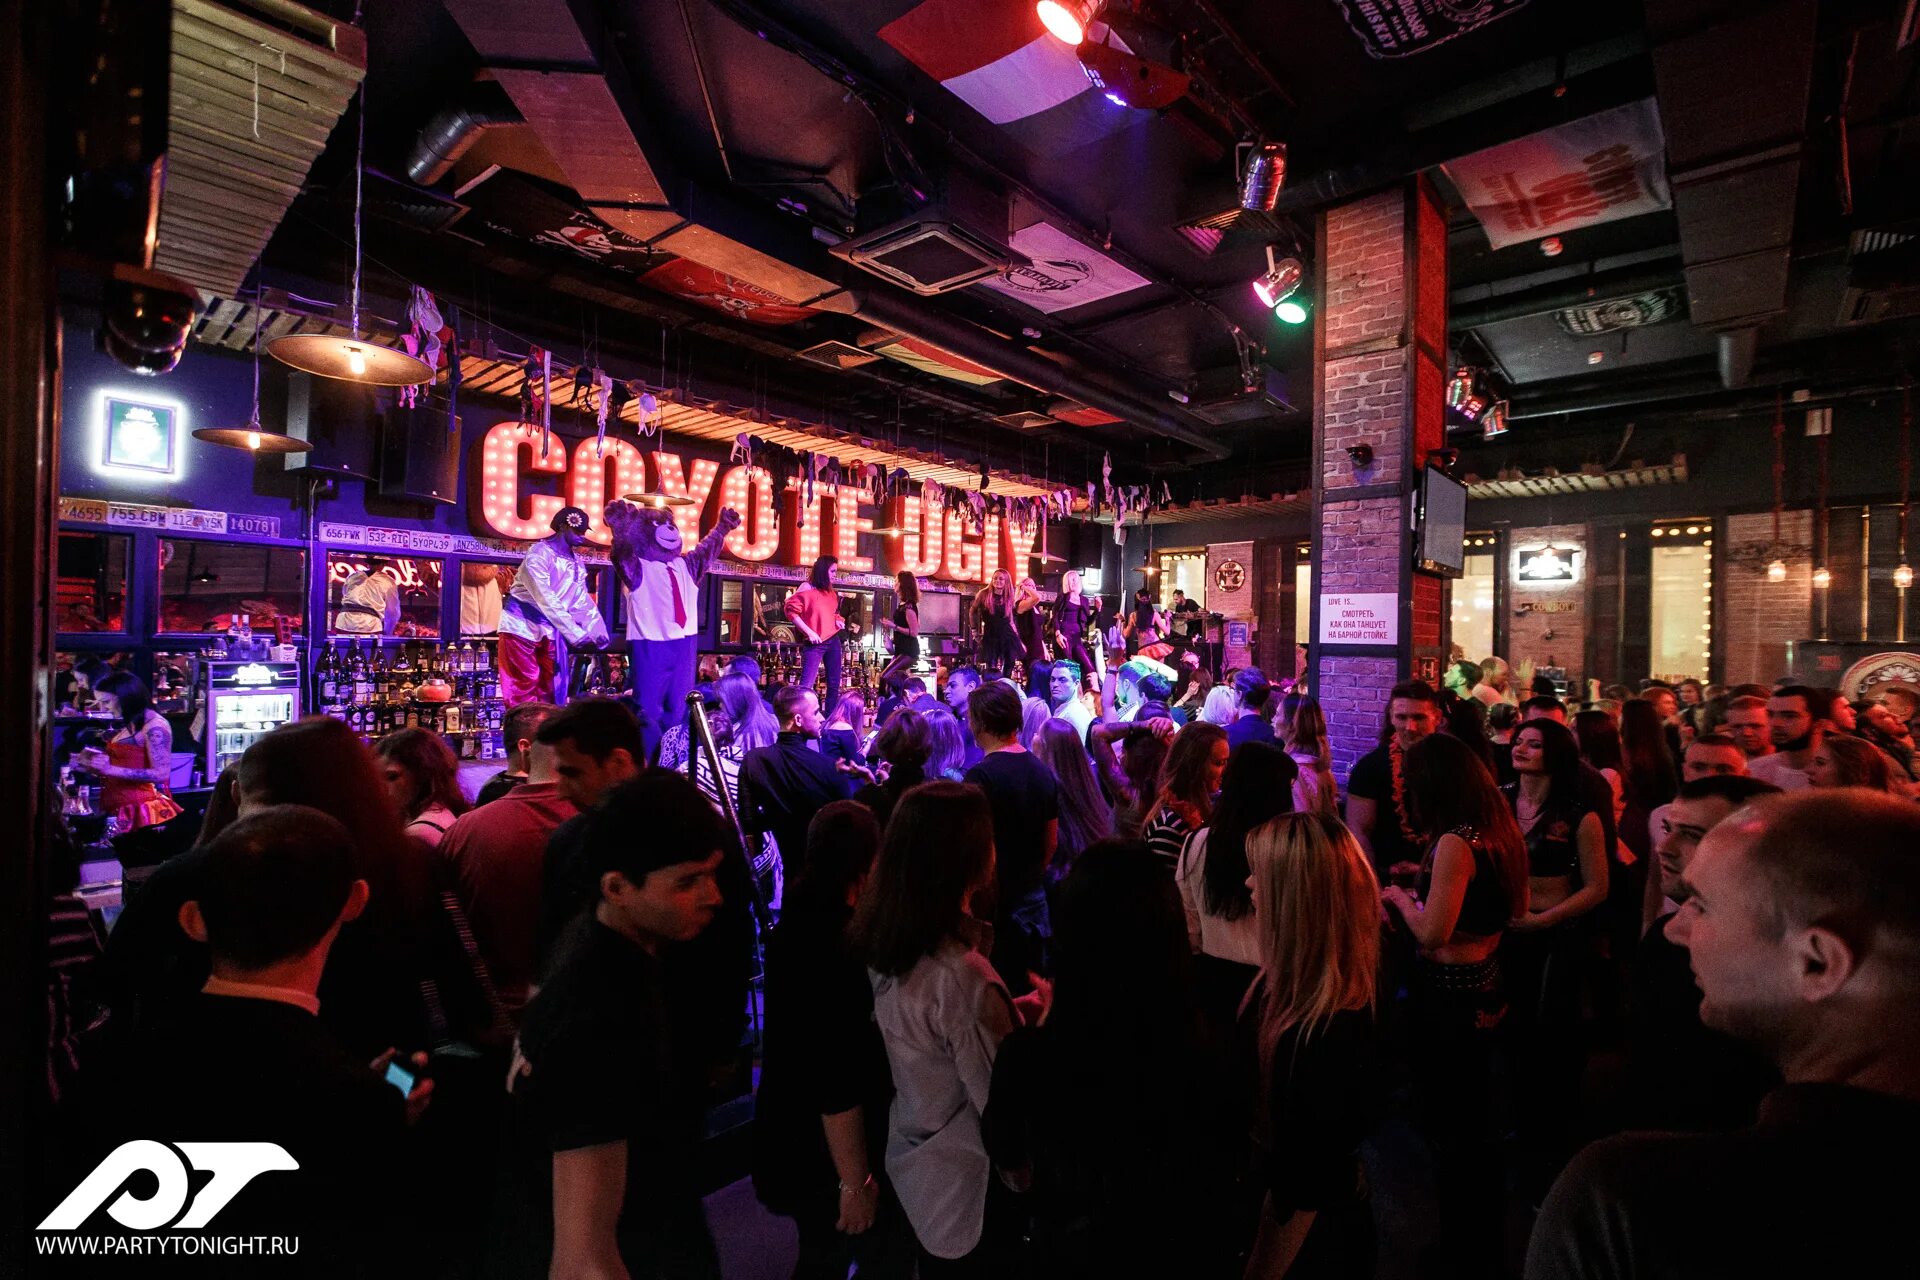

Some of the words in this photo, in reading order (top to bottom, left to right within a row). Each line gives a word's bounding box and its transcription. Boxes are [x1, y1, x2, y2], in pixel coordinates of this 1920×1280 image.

[482, 421, 874, 573] COYOTE
[902, 495, 1037, 586] UGLY
[1328, 631, 1337, 639] НА
[1338, 630, 1362, 639] БАРНОЙ
[1363, 630, 1388, 639] СТОЙКЕ
